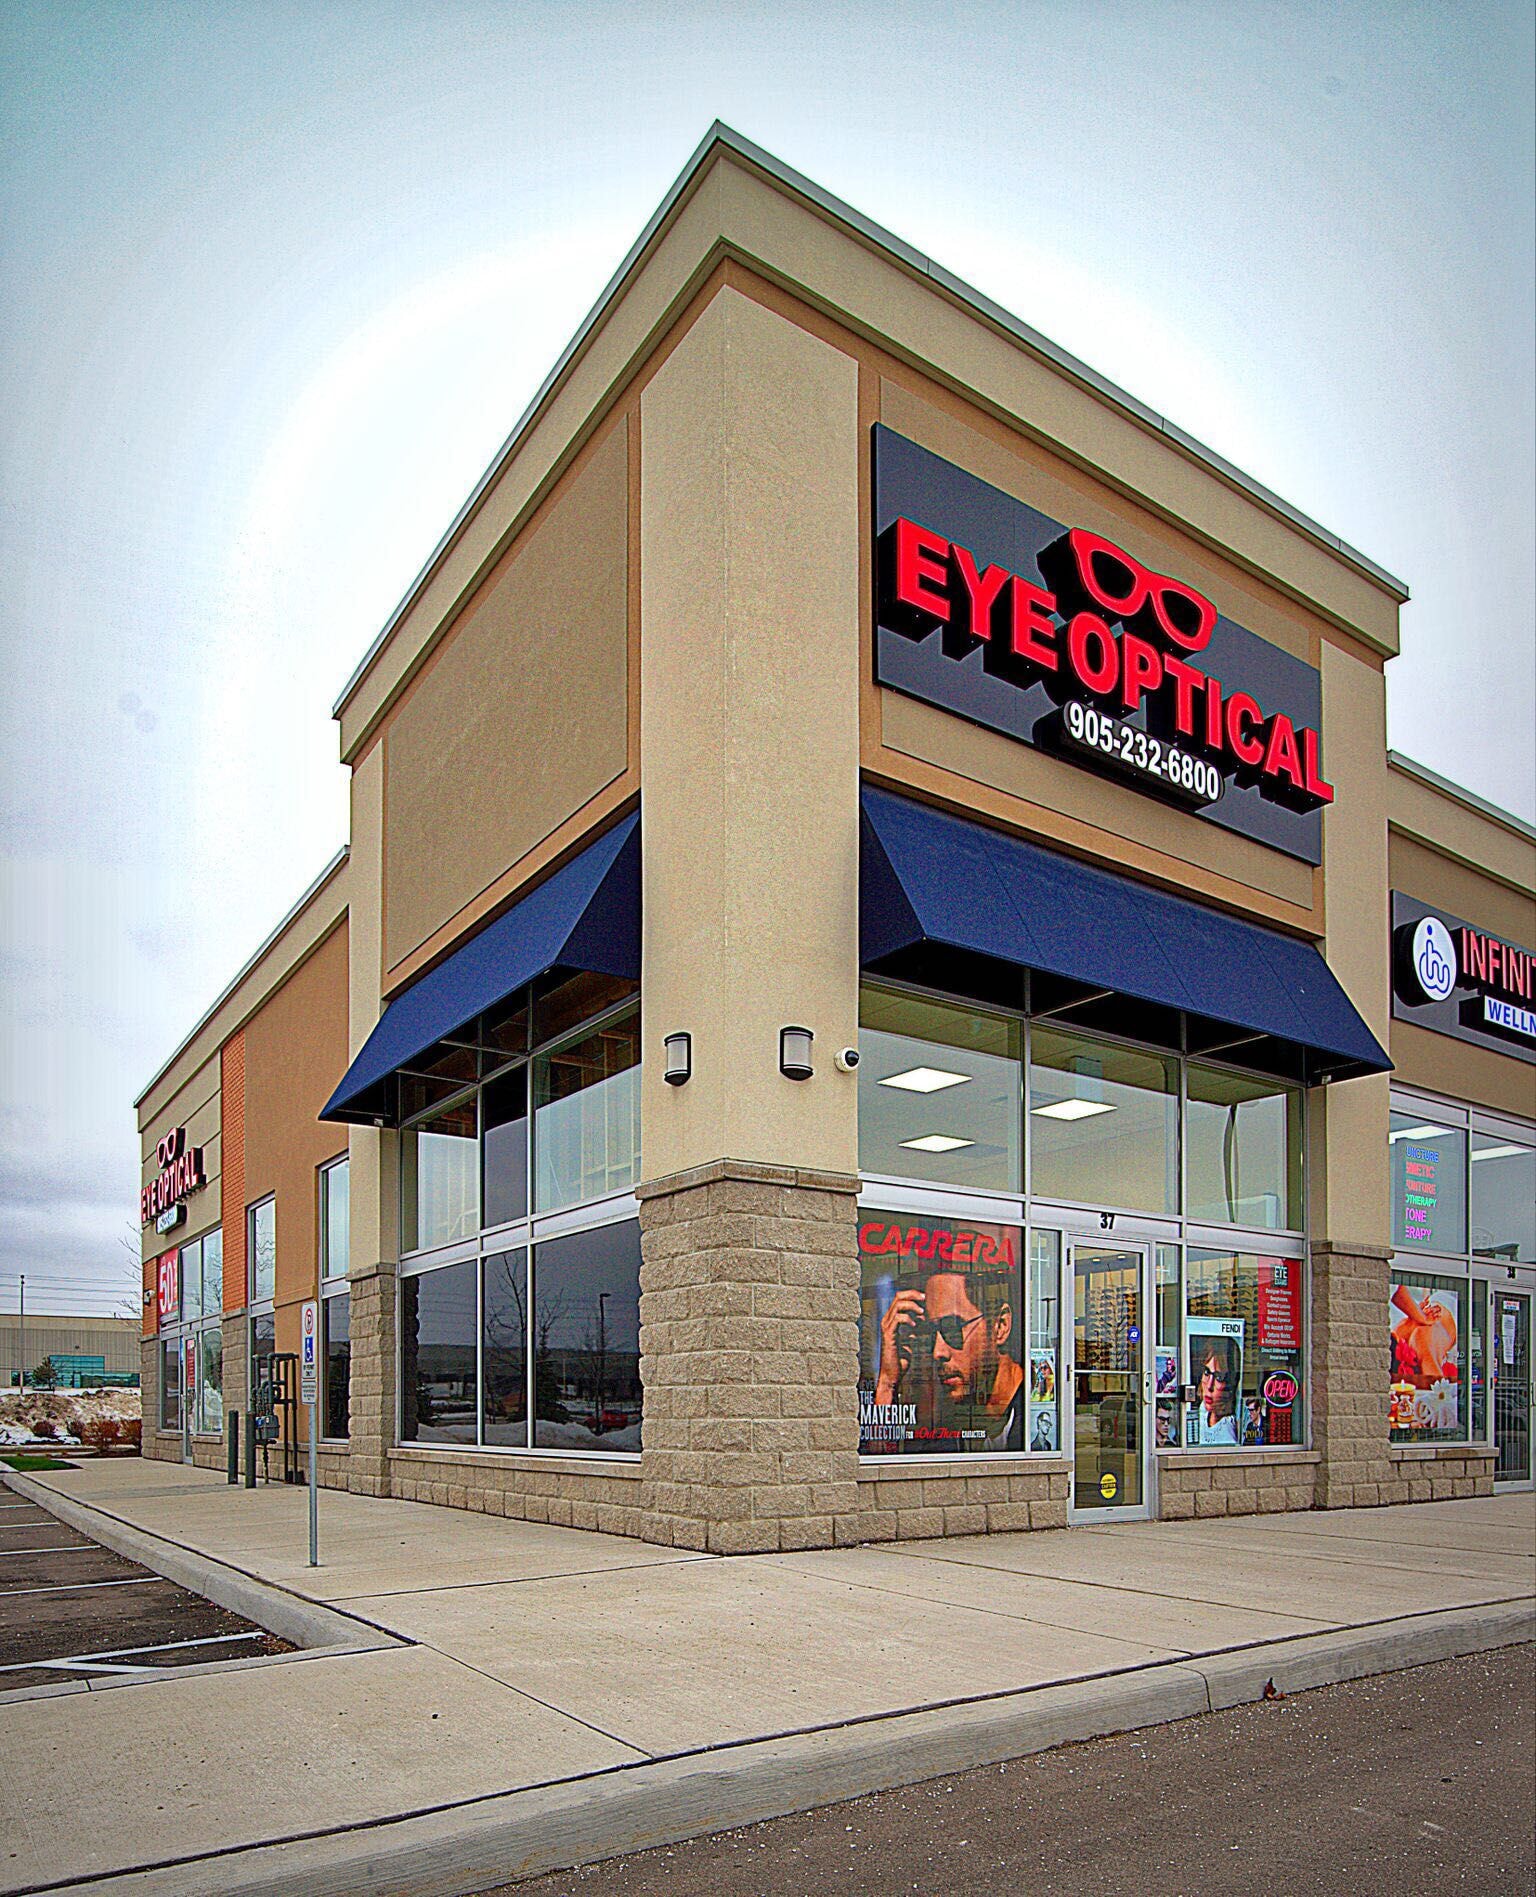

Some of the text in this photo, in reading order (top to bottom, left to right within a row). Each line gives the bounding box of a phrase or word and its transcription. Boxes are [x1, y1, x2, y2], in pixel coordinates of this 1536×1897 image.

[897, 516, 1334, 802] EYE OPTICAL
[1069, 701, 1219, 800] 905-232-6800
[1101, 1212, 1115, 1230] 37
[859, 1222, 1015, 1267] CARRERA
[1222, 1324, 1241, 1333] FENDI
[860, 1391, 874, 1404] THE
[1266, 1379, 1295, 1398] OPEN
[860, 1404, 917, 1425] MAVERICK
[860, 1425, 906, 1440] COLLECTION
